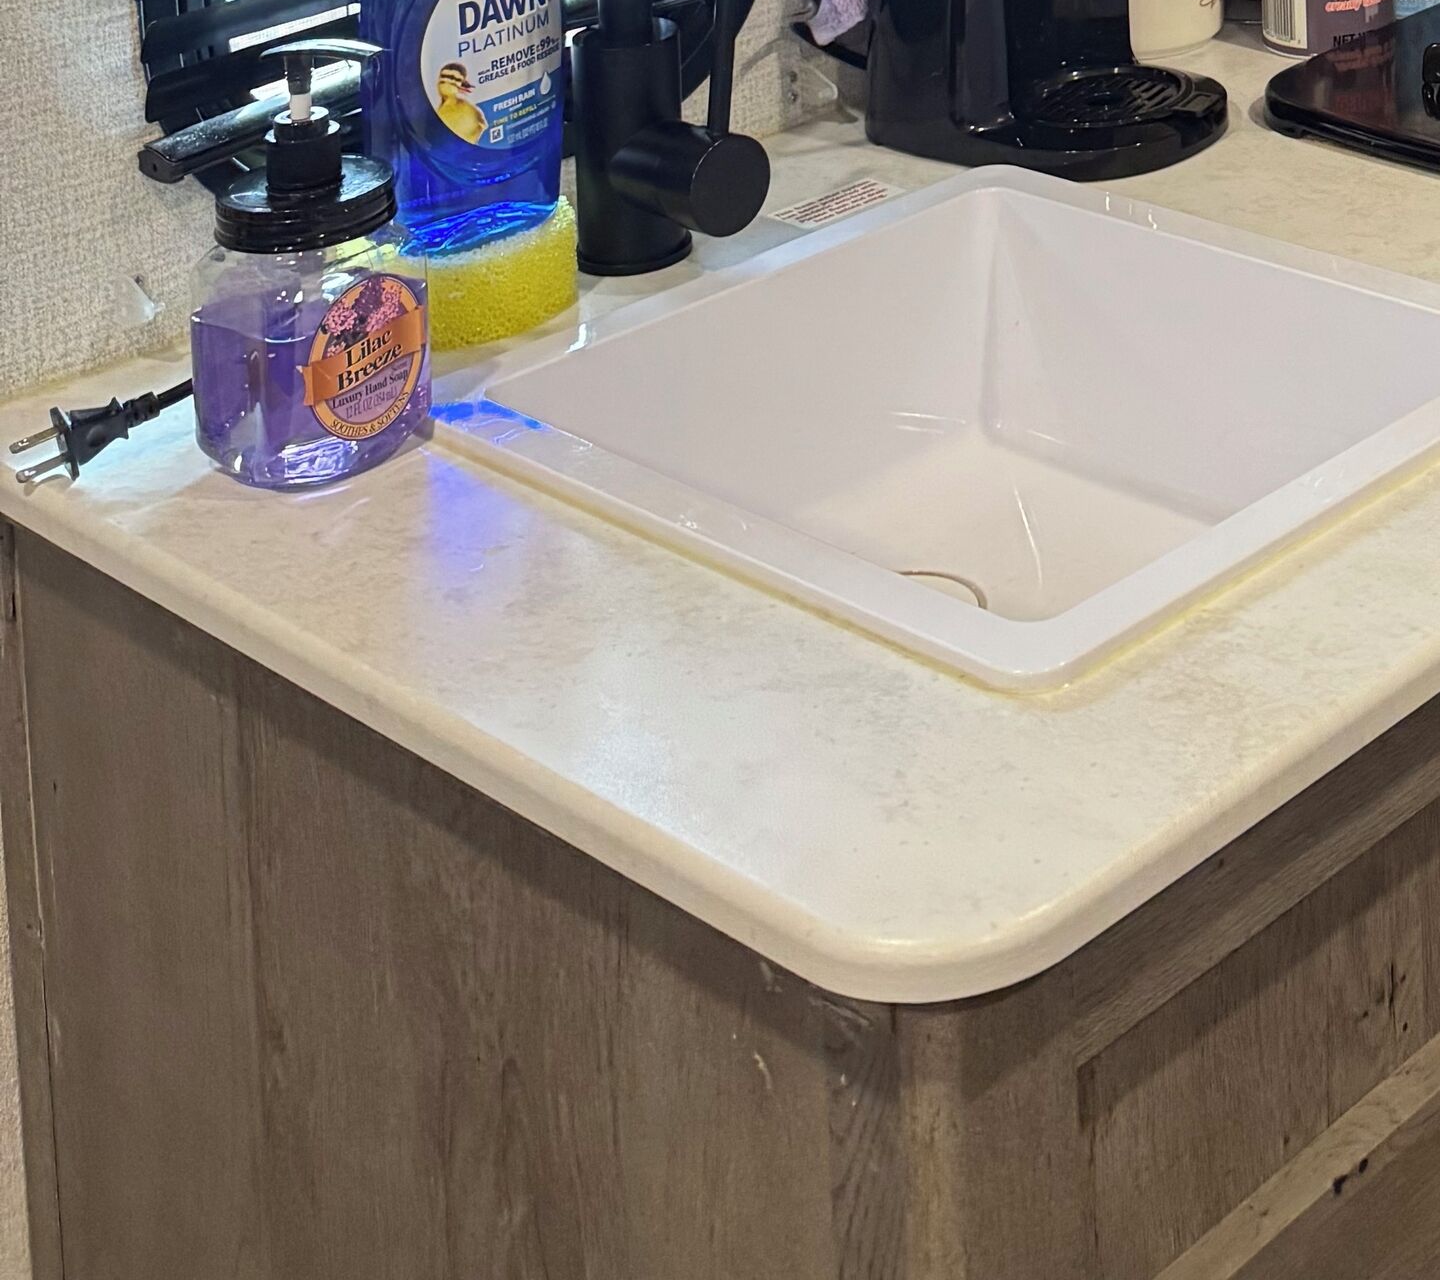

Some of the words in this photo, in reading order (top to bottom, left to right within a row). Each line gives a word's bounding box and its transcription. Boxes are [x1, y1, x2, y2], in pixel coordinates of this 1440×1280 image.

[458, 10, 550, 58] PLATINUM
[478, 67, 510, 85] GREASE
[517, 54, 537, 72] FOOD
[490, 43, 536, 71] REMOVE
[493, 95, 519, 113] FRESH
[517, 87, 536, 104] RAIN
[345, 329, 391, 369] Lilac
[337, 343, 402, 393] Breeze
[332, 391, 363, 410] Luxury
[364, 378, 388, 397] Hand
[389, 368, 408, 383] Soap
[329, 419, 369, 437] SOOTHES
